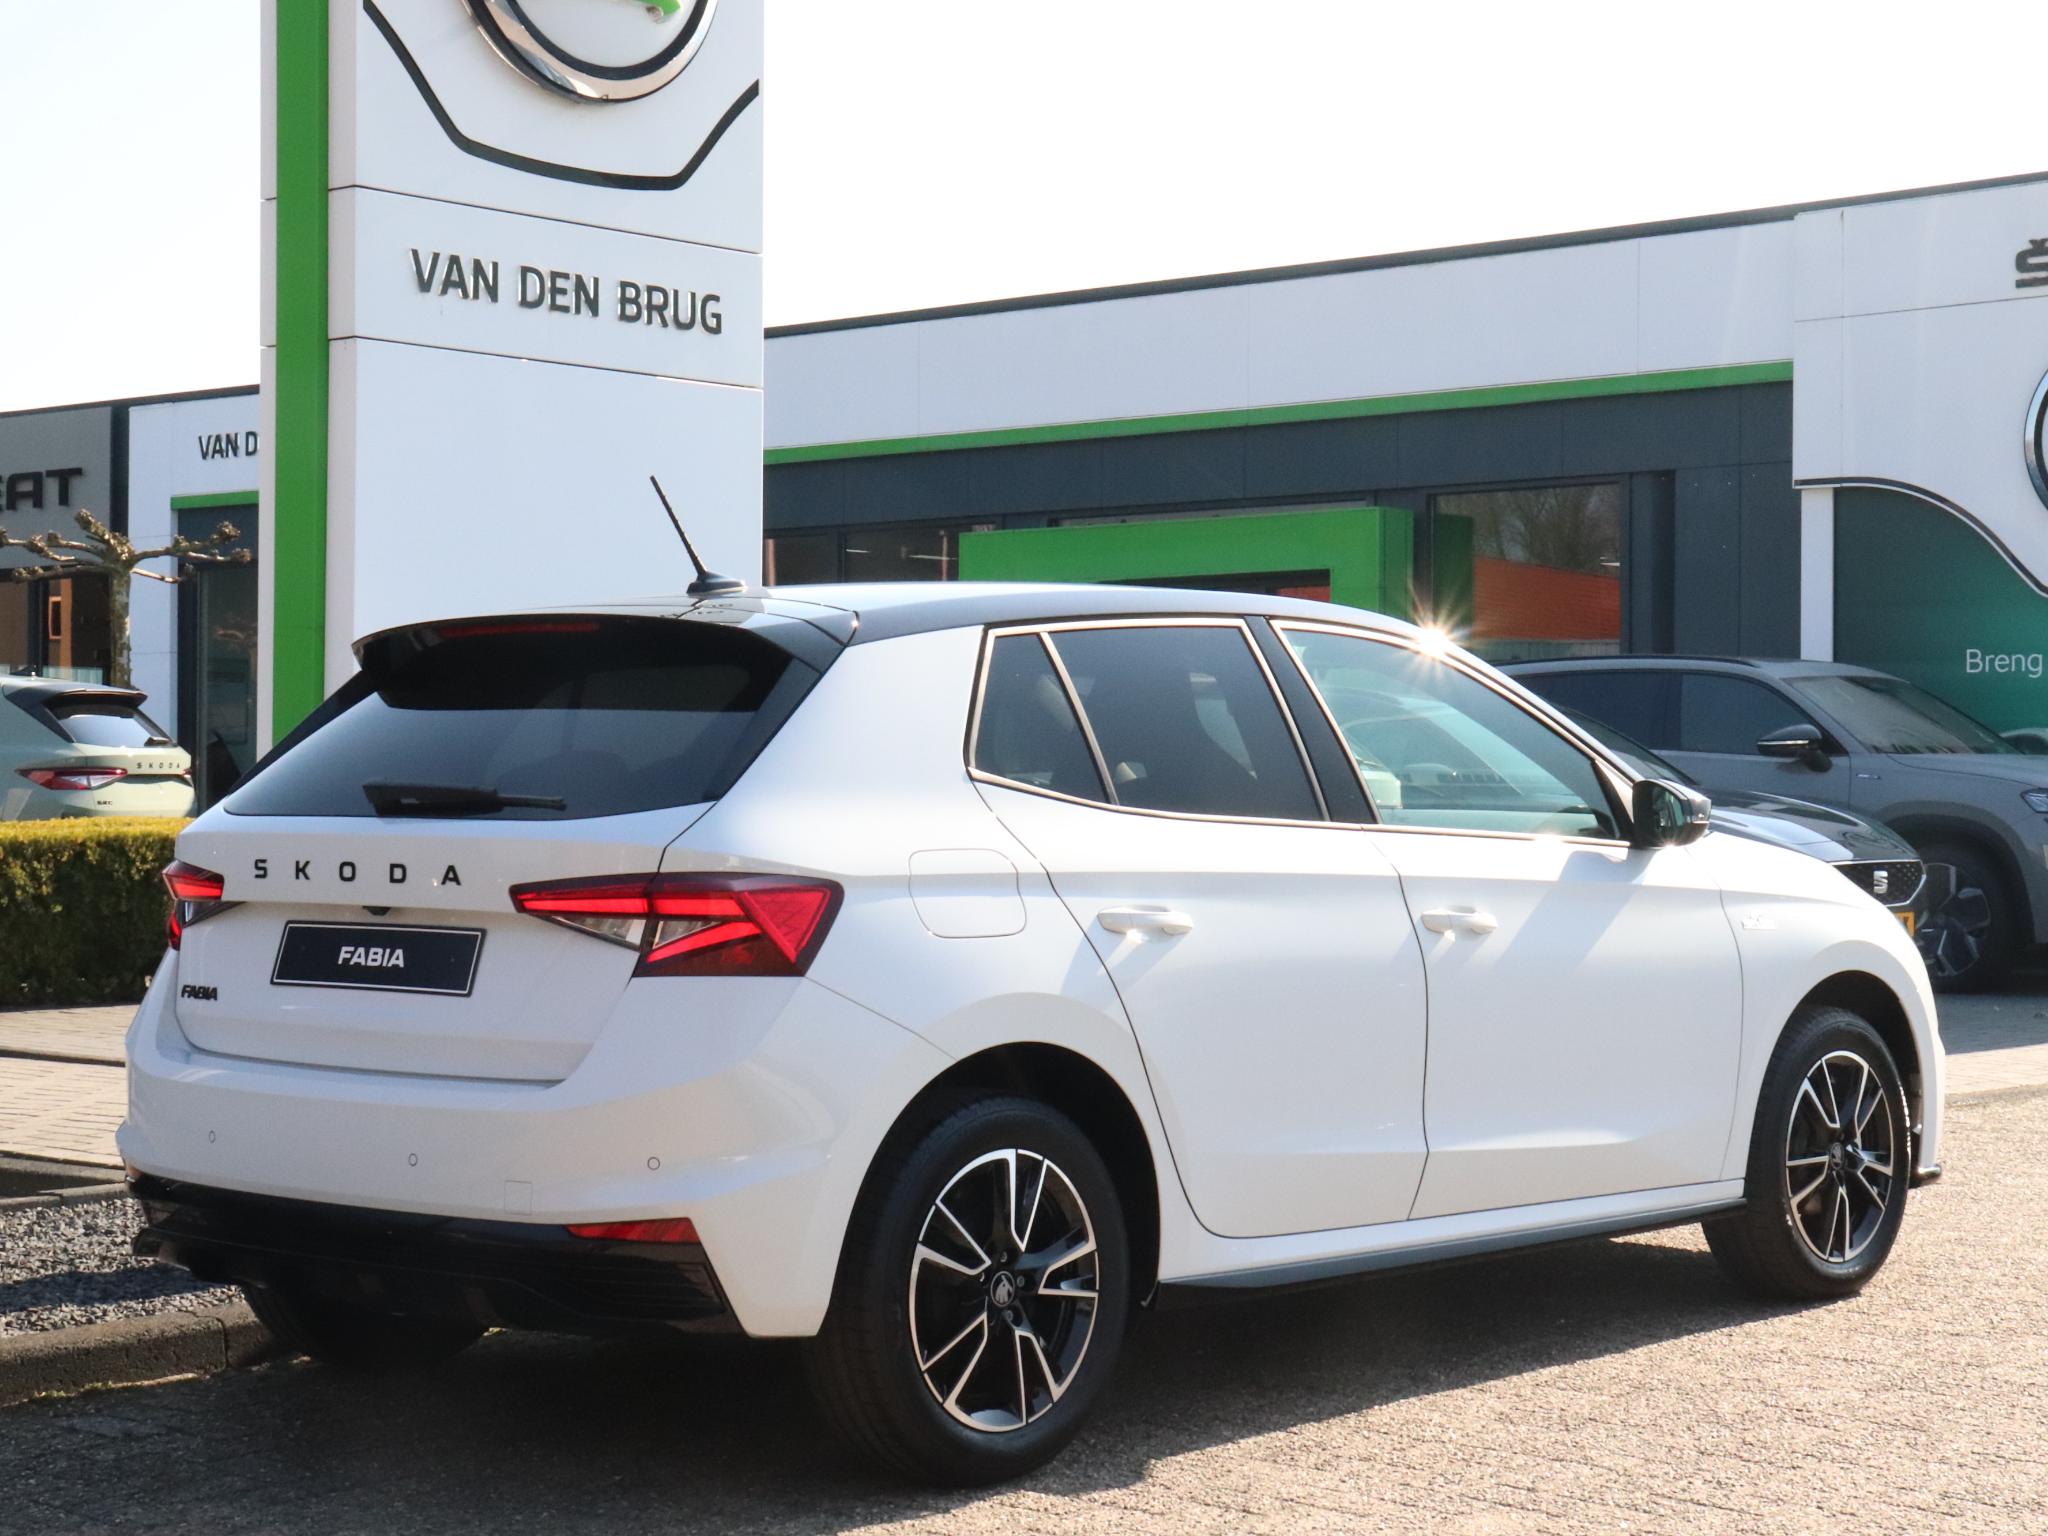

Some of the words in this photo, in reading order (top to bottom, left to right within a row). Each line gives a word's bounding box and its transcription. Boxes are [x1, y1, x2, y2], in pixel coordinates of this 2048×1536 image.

[409, 248, 500, 304] VAN
[517, 265, 600, 318] DEN
[617, 280, 723, 335] BRUG
[198, 431, 240, 461] VAN
[0, 467, 83, 512] AT
[1966, 648, 2043, 679] Breng
[254, 859, 462, 886] SKODA
[337, 946, 405, 968] FABIA
[181, 984, 218, 1001] FABIA
